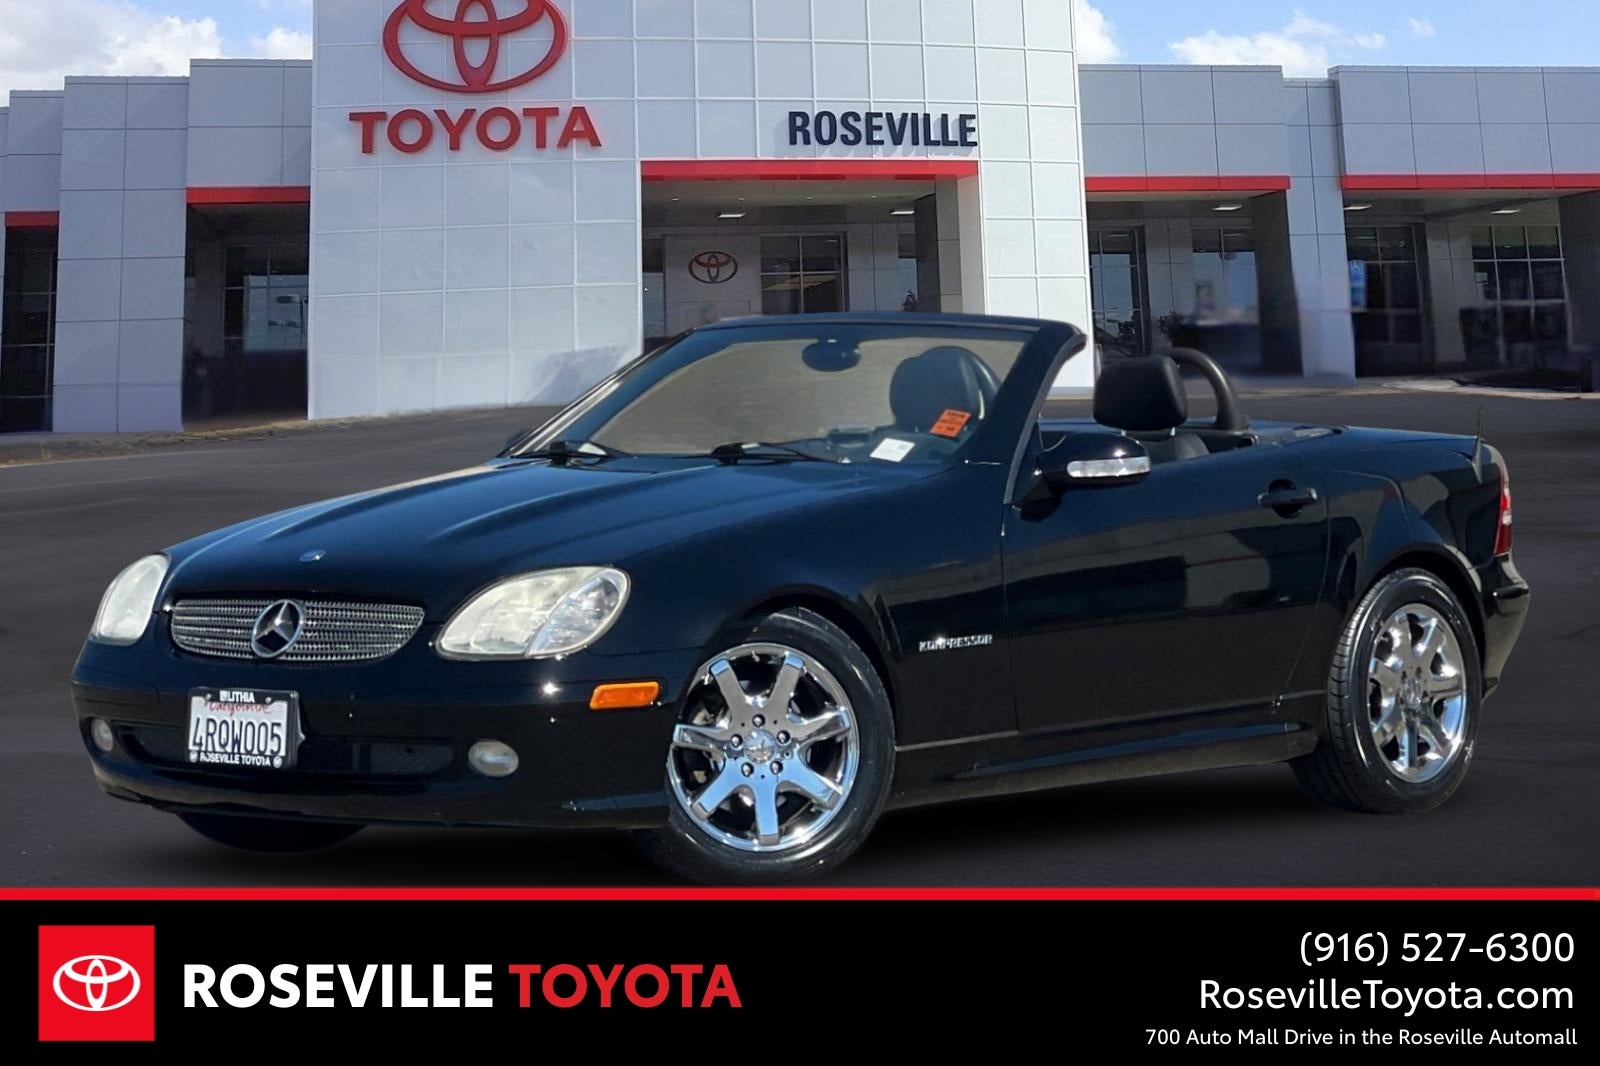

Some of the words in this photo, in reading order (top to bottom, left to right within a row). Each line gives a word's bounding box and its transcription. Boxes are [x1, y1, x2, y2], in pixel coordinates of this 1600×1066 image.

[349, 106, 602, 154] TOYOTA
[788, 110, 979, 147] ROSEVILLE
[918, 633, 993, 652] KOMPRESSOR
[228, 690, 256, 703] LITHIA
[192, 716, 282, 756] 4RQW005
[199, 752, 239, 765] ROSEVILLE
[241, 754, 271, 767] TOYOTA
